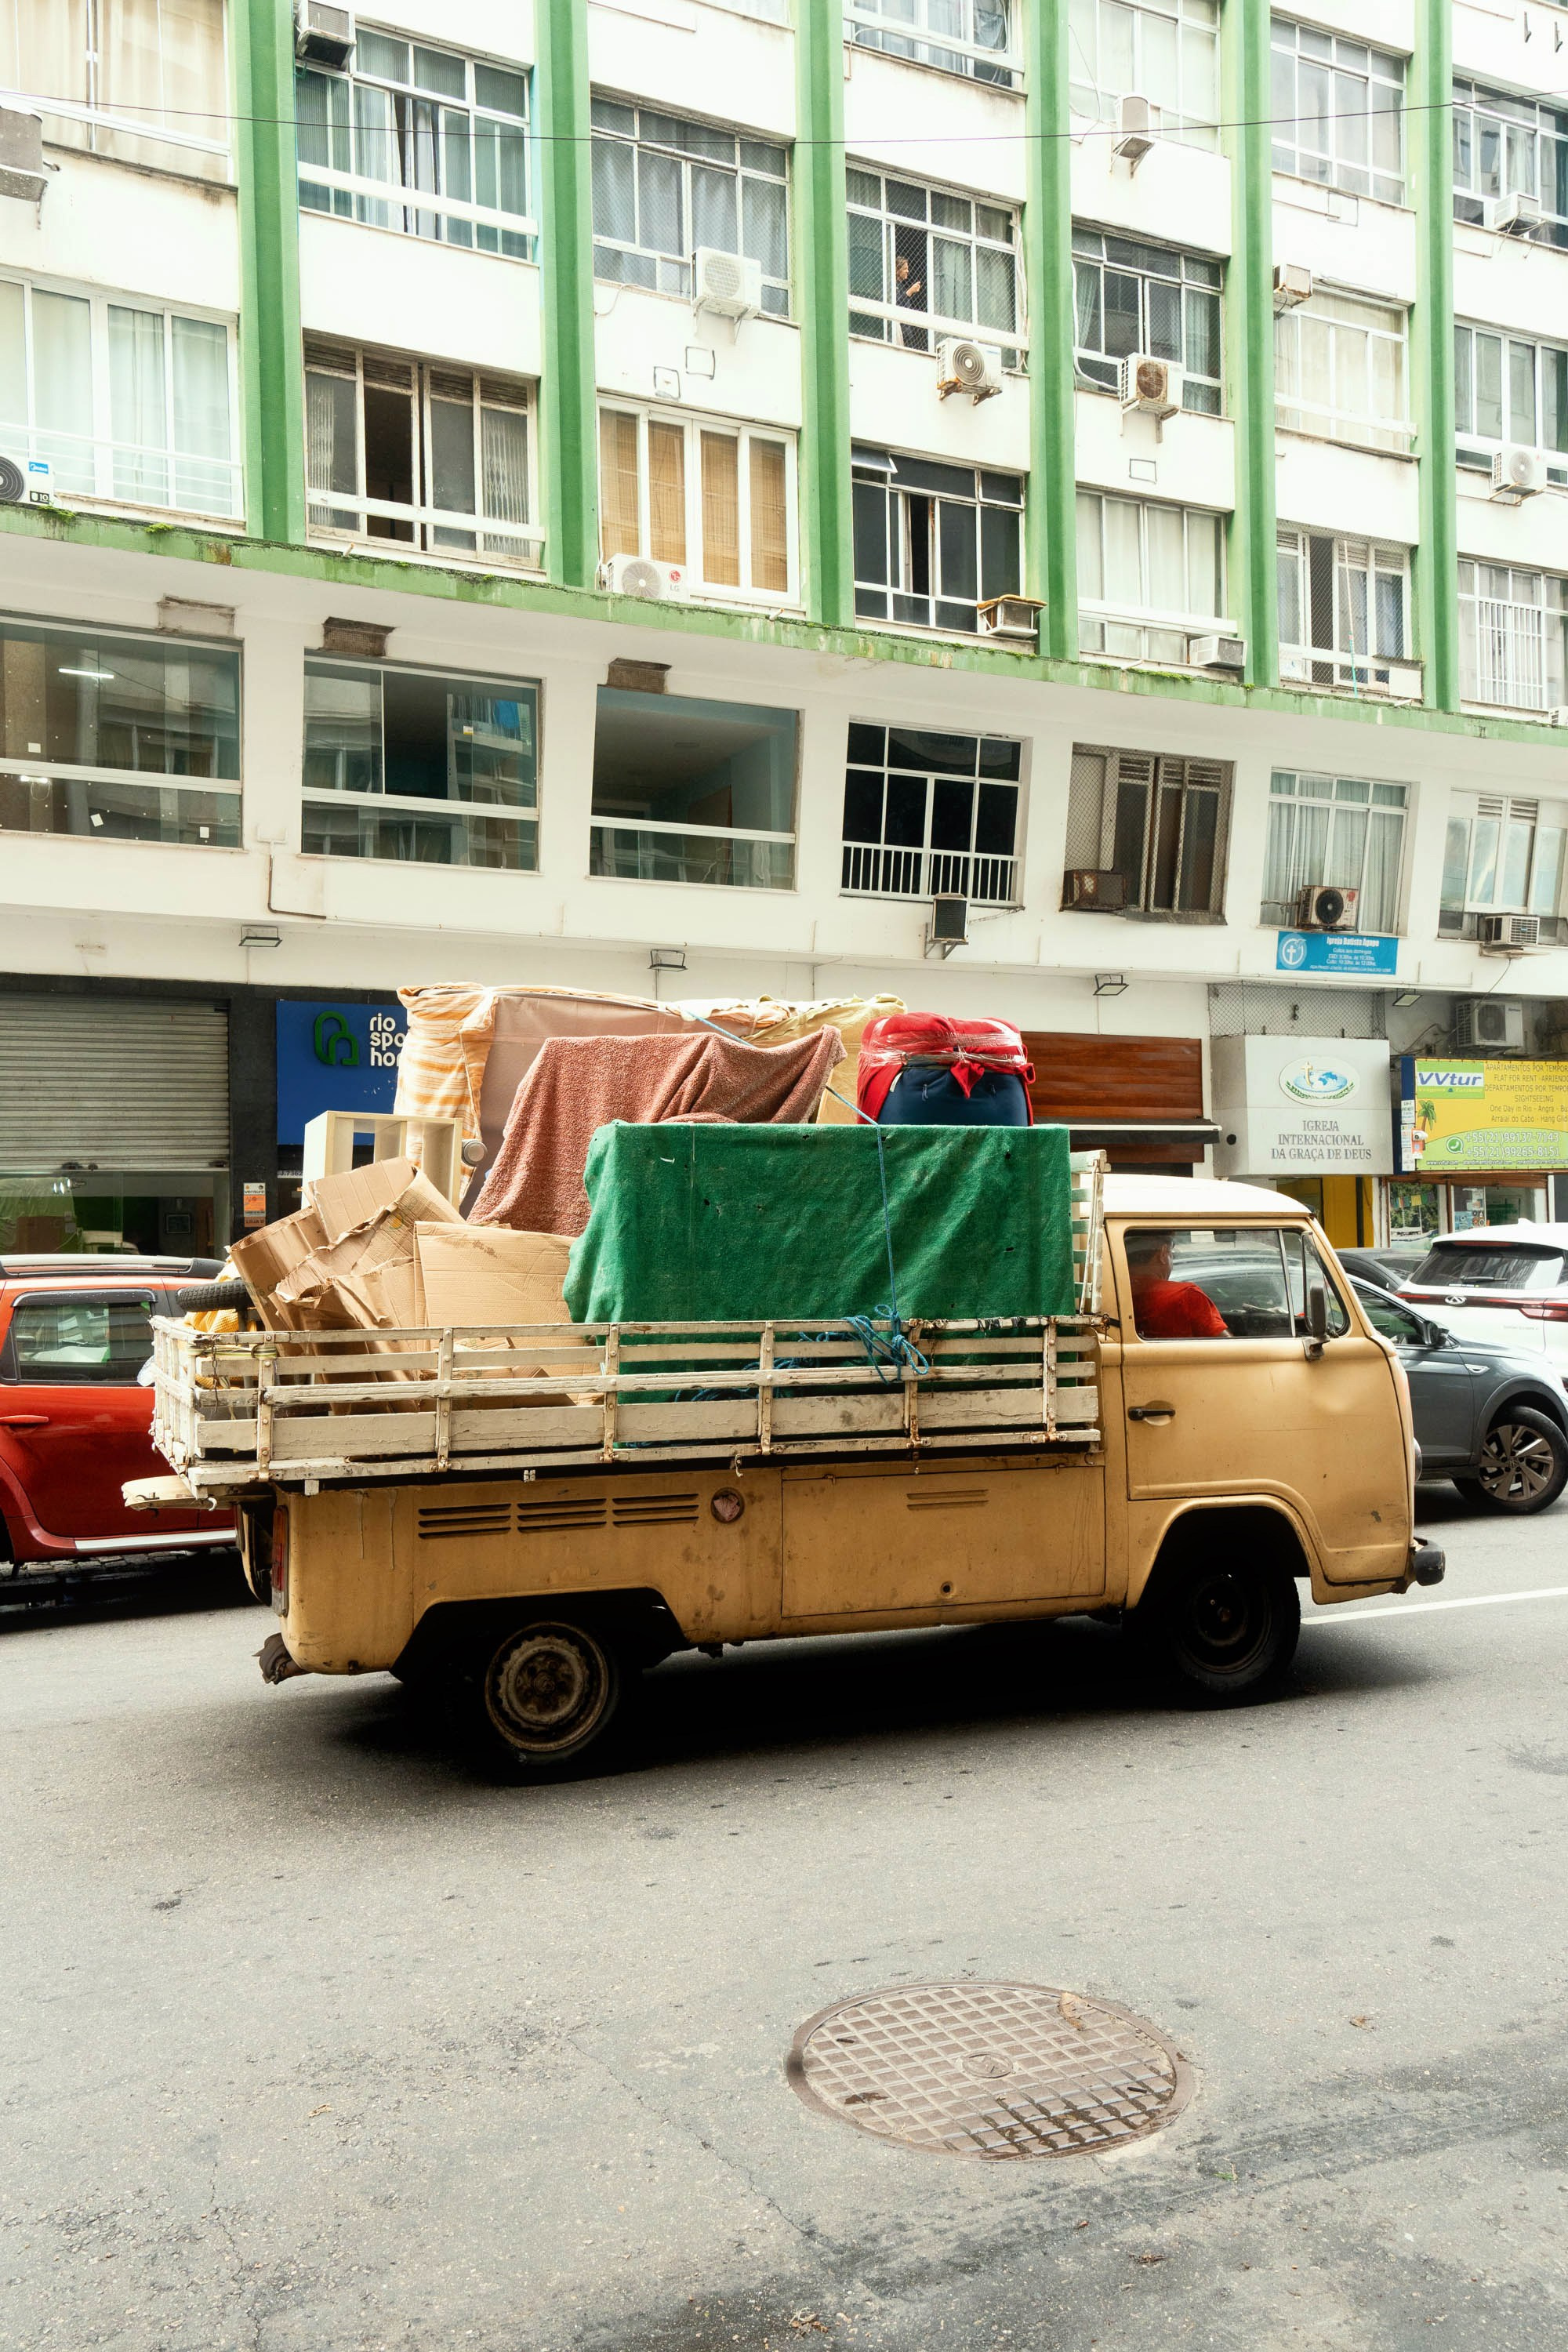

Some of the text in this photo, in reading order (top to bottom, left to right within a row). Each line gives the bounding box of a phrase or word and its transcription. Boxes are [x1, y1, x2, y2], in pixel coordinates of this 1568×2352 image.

[369, 1013, 396, 1032] rio
[1486, 1064, 1531, 1073] APARTAMENTOS
[1418, 1073, 1483, 1086] VVtur
[1503, 1105, 1515, 1113] Day
[1302, 1120, 1340, 1131] IGREJA
[1541, 1116, 1555, 1124] Hang
[1278, 1134, 1364, 1146] INTERNACIONAL
[1465, 1131, 1560, 1145] +55(21)99137-7143
[1271, 1148, 1372, 1162] DA GRAÇA DE DEUS
[1466, 1145, 1560, 1159] +55(21)99265-8151
